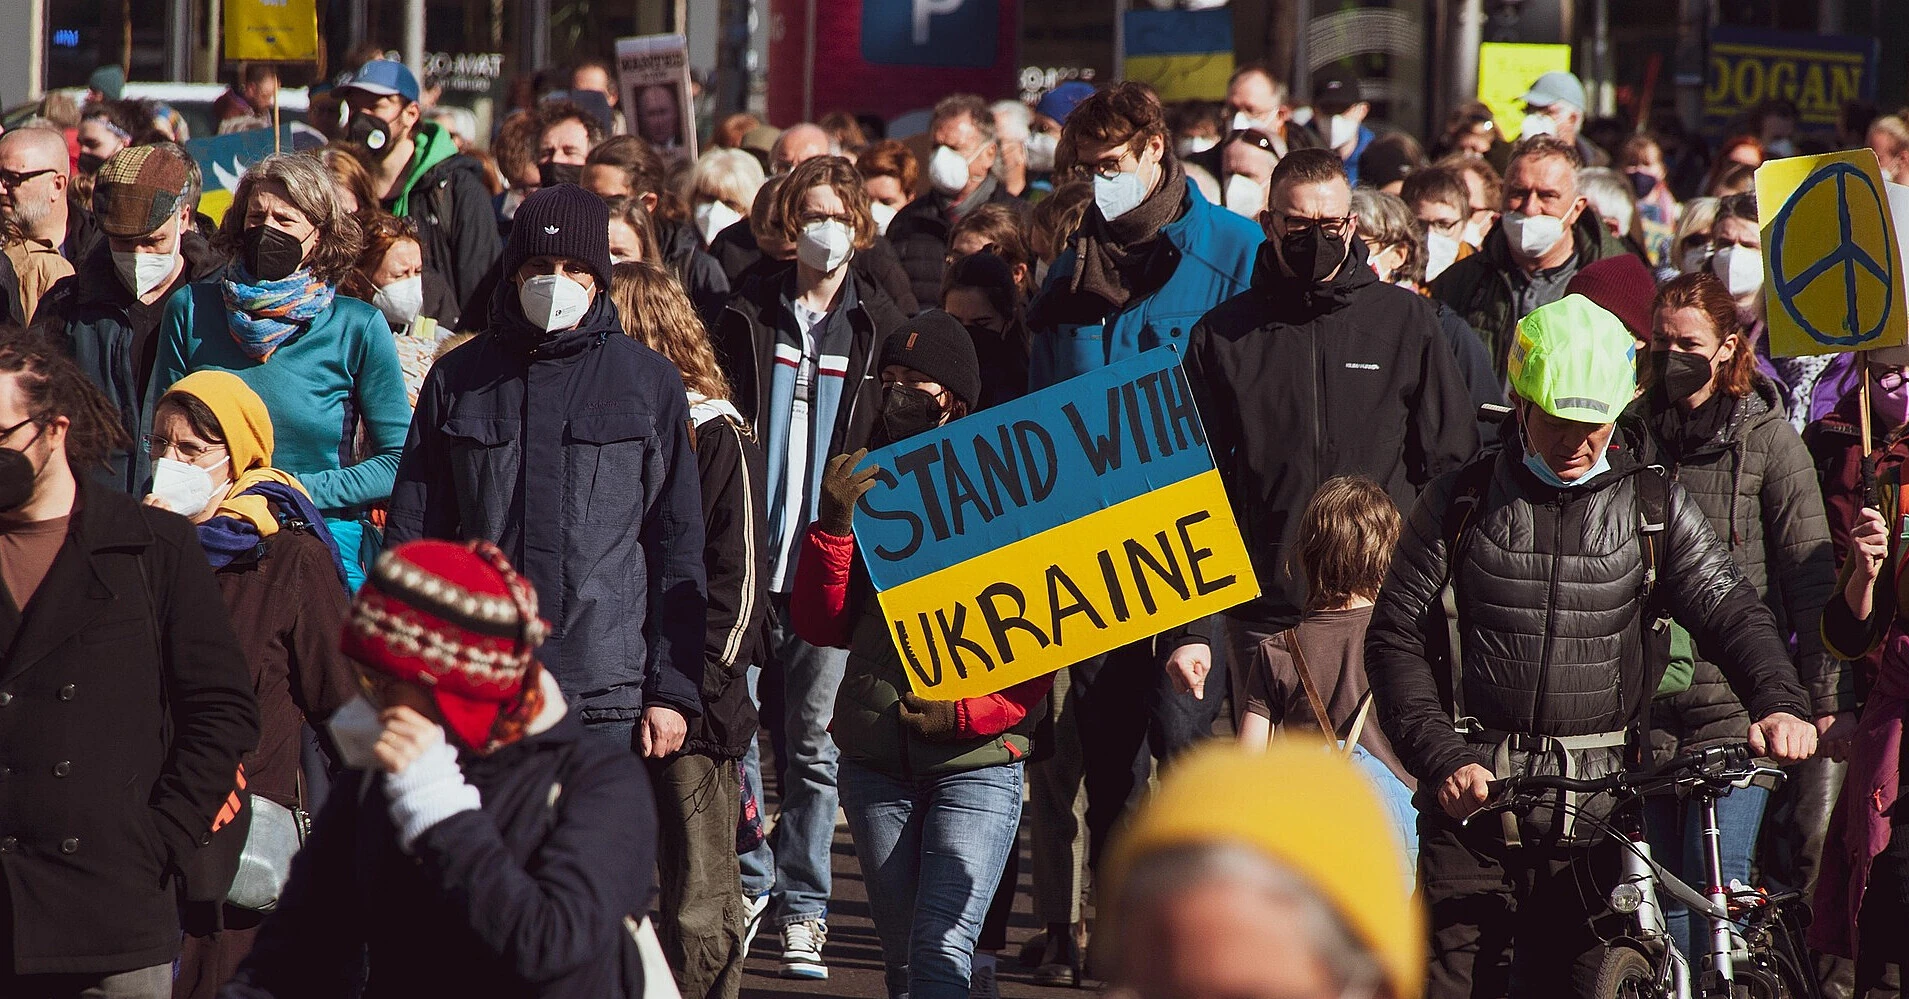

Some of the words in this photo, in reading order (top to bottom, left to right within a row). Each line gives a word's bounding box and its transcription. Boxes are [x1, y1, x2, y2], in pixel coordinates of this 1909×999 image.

[859, 419, 1058, 562] STAND
[1061, 365, 1205, 477] WITH
[895, 510, 1237, 687] UKRAINE
